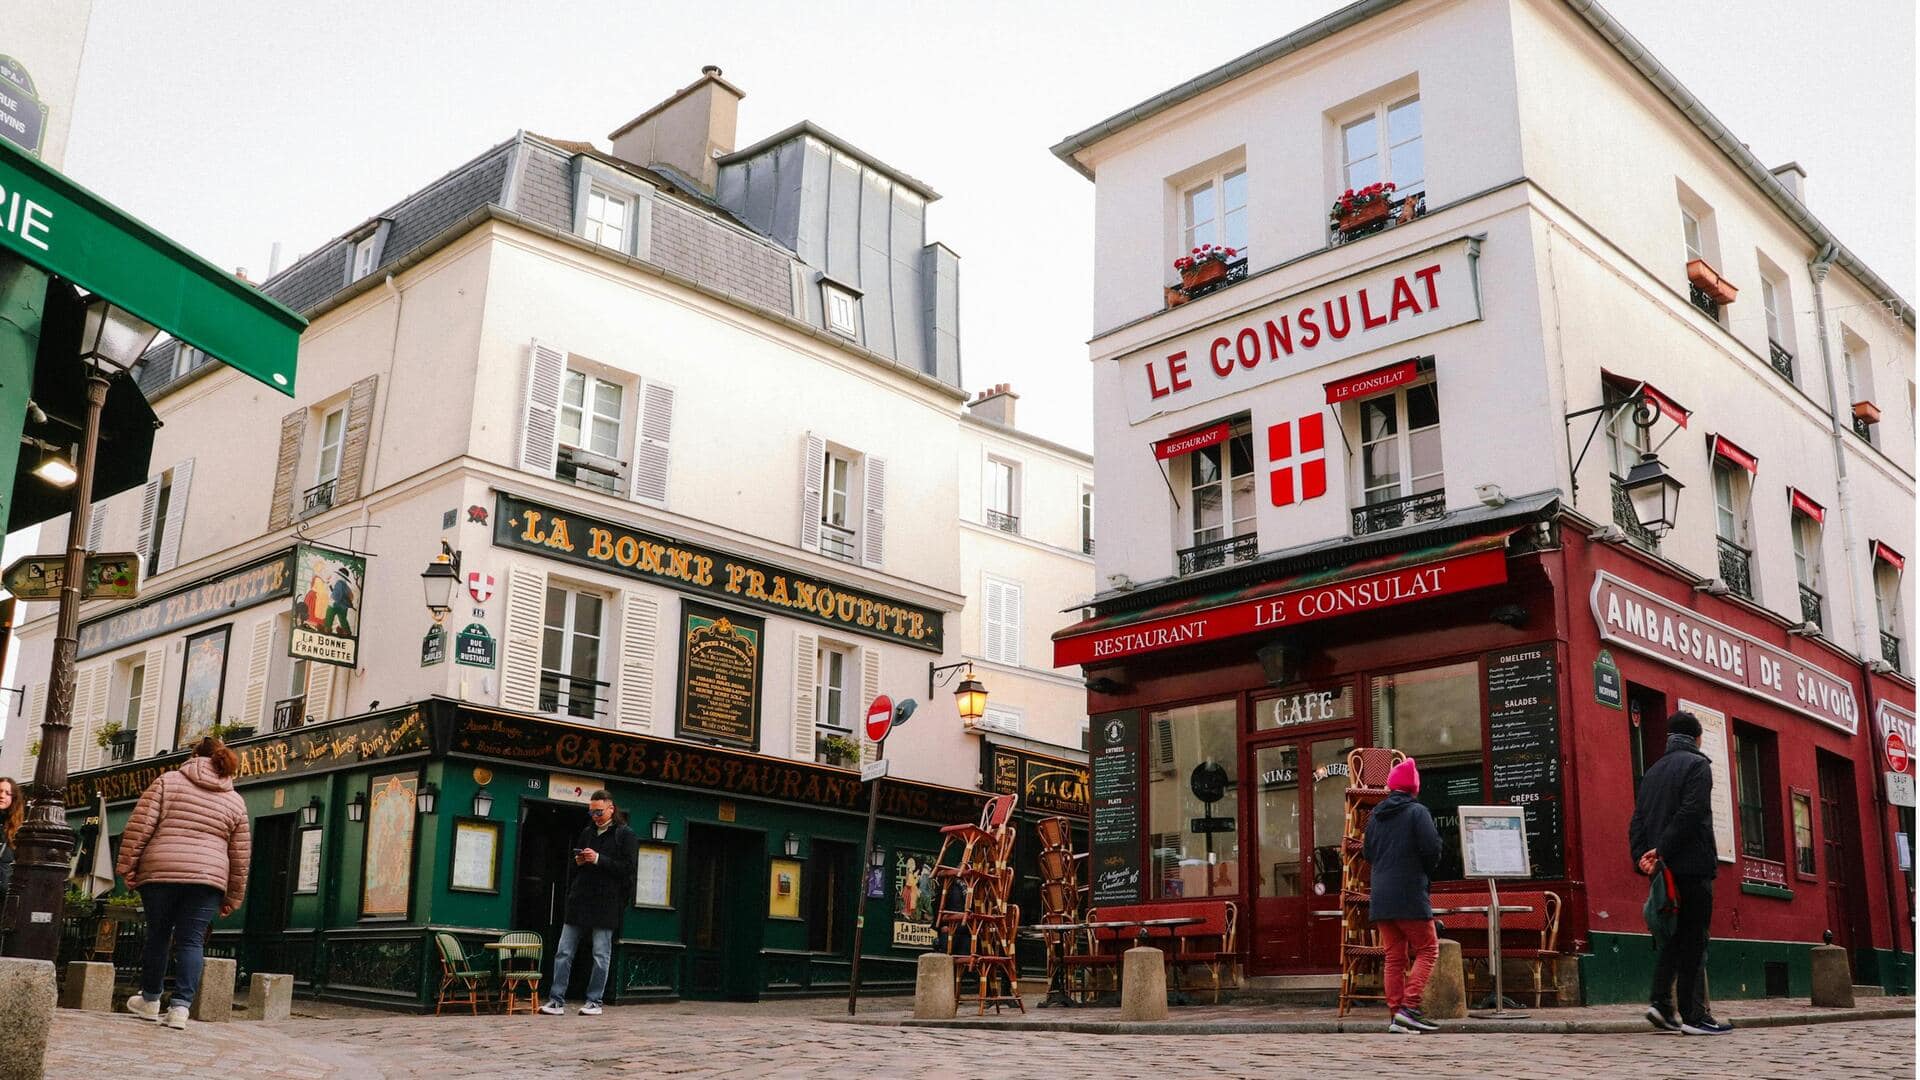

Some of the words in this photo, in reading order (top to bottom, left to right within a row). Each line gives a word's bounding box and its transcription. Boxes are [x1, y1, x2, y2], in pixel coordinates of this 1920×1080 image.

[0, 184, 53, 251] IE
[1145, 351, 1192, 400] LE
[1210, 264, 1443, 378] CONSULAT
[1336, 386, 1349, 398] LE
[1352, 371, 1405, 394] CONSULAT
[1167, 431, 1219, 454] RESTAURANT
[521, 510, 575, 552] LA
[587, 527, 713, 586] BONNE
[725, 563, 924, 639] FRANQUETTE
[1094, 621, 1207, 657] RESTAURANT
[1254, 601, 1286, 627] LE
[1298, 566, 1446, 617] CONSULAT
[303, 633, 313, 642] LA
[318, 636, 346, 649] BONNE
[429, 638, 440, 647] RUE
[470, 639, 482, 647] RUE
[296, 641, 351, 660] FRANQUETTE
[460, 652, 491, 663] RUSTIQUE
[467, 646, 485, 655] SAINT
[1500, 651, 1541, 663] OMELETTES
[1607, 592, 1744, 677] AMBASSADE
[1760, 655, 1782, 692] DE
[1797, 672, 1854, 722] SAVOIE
[1505, 697, 1538, 708] SALADES
[530, 779, 539, 788] 18
[661, 749, 864, 808] RESTAURANT
[1262, 769, 1292, 784] VINS
[1044, 780, 1056, 795] LA
[1511, 793, 1539, 803] CRÊPES
[901, 923, 909, 932] LA
[911, 924, 931, 933] BONNE
